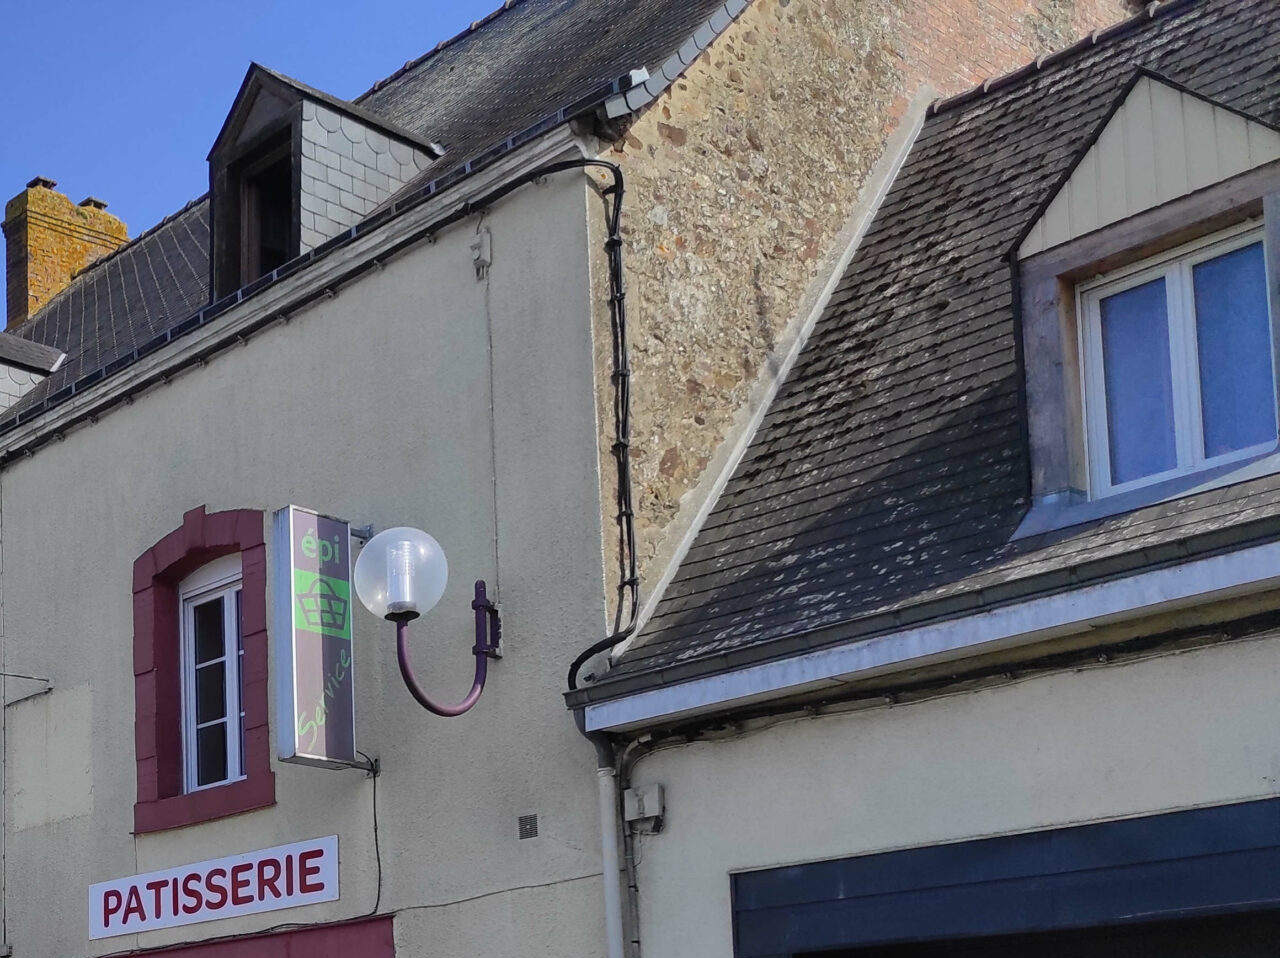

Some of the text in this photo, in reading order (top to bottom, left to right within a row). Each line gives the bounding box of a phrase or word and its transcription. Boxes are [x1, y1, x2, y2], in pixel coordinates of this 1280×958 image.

[301, 528, 340, 568] épi
[297, 649, 351, 751] Service
[103, 848, 325, 928] PATISSERIE
